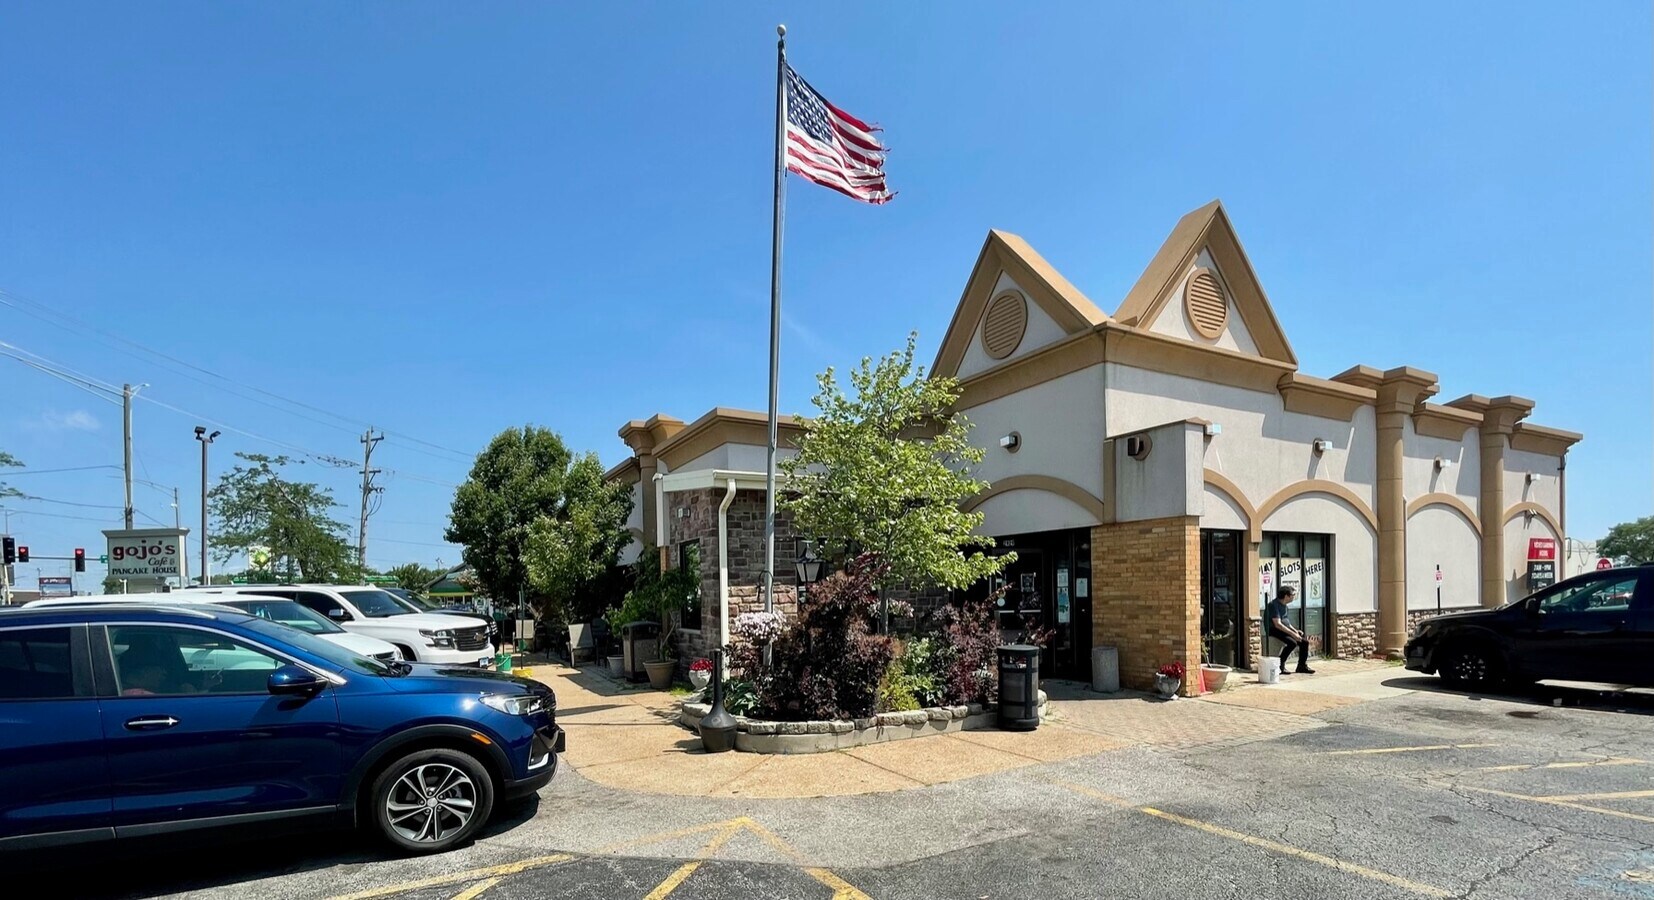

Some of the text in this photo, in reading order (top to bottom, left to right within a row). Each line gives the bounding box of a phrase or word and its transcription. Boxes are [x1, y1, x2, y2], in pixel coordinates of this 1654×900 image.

[112, 540, 176, 560] gojo's
[112, 566, 178, 575] PANCAKE HOUSE
[1259, 560, 1324, 577] LAY SLOTS HERE!
